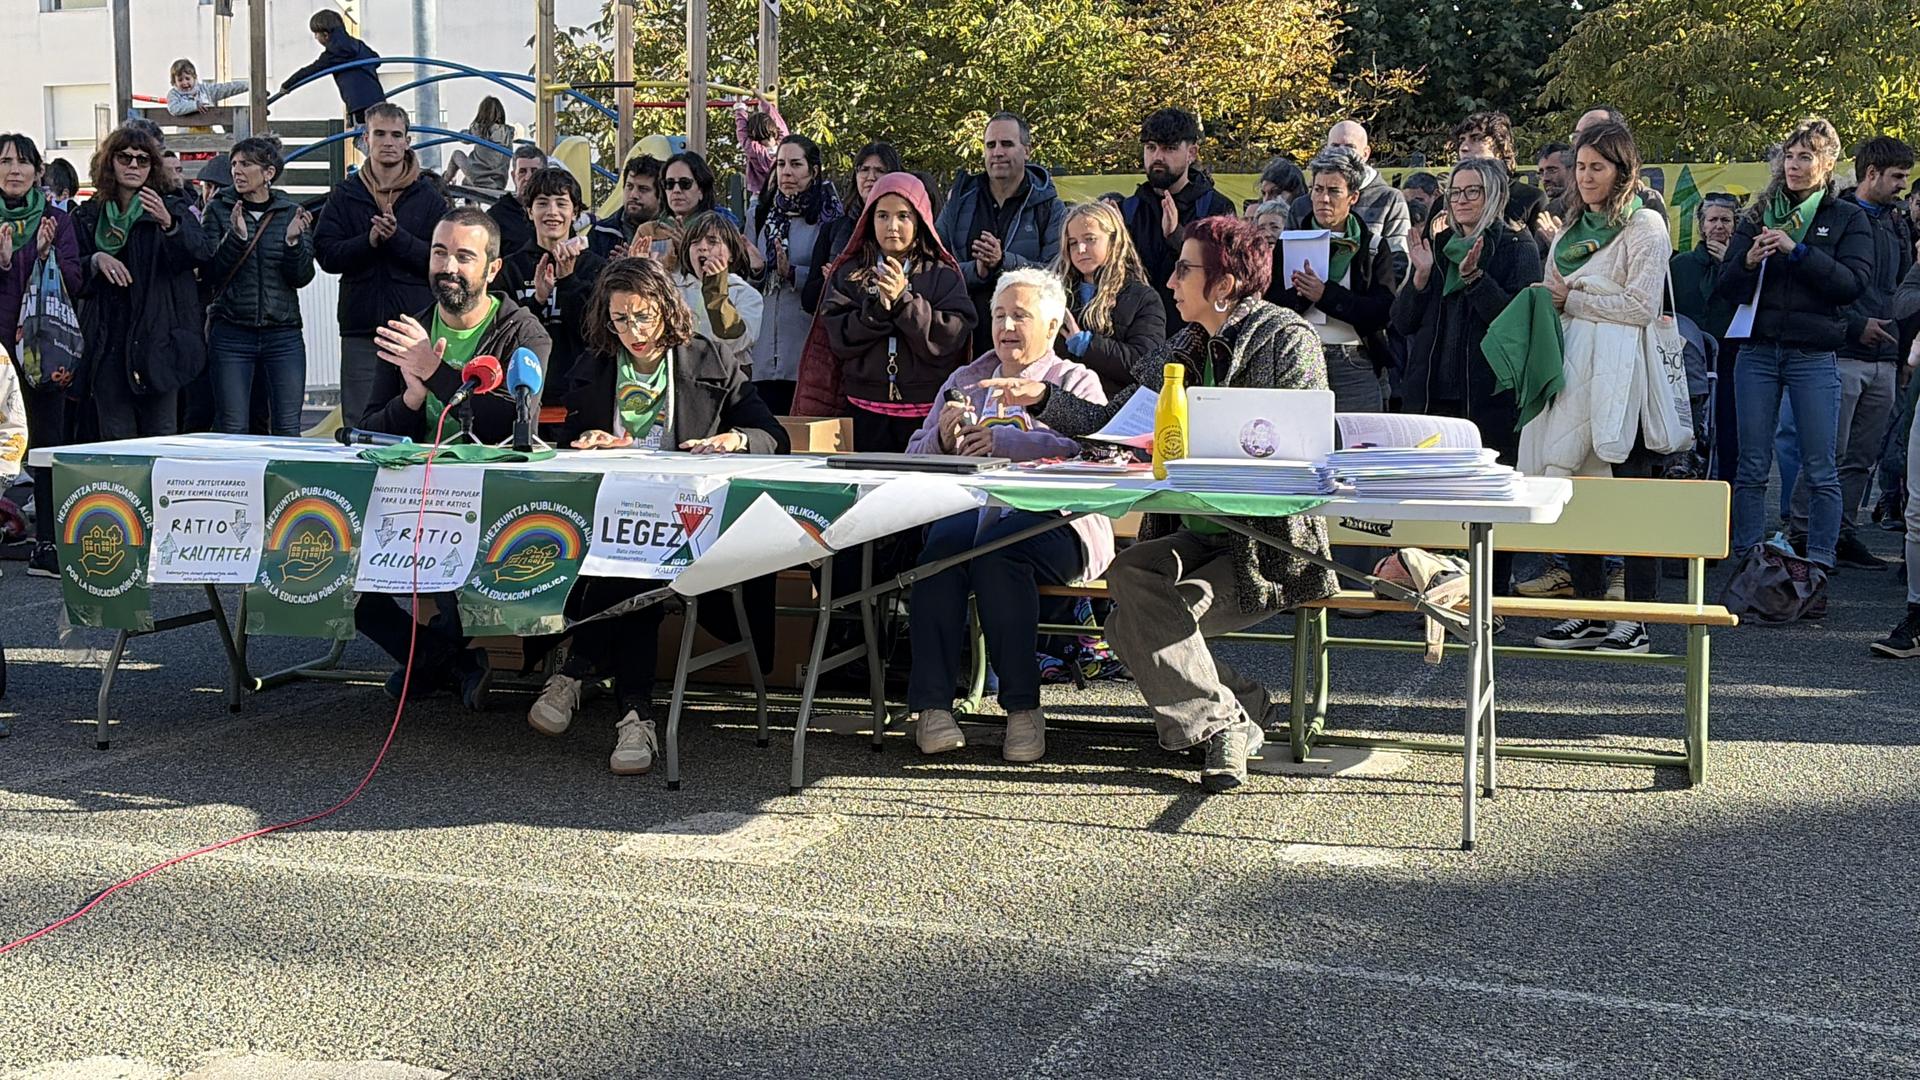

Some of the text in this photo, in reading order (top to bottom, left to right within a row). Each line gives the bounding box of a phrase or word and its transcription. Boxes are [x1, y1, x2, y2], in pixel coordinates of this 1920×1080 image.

[57, 481, 154, 529] HEZKUNTZA PUBLIKOAREN ALDE
[265, 486, 362, 534] HEZKUNTZA PUBLIKOAREN ALDE
[408, 498, 434, 506] BAJDA
[679, 505, 707, 515] JAITSI
[171, 518, 228, 534] RATIO
[482, 504, 530, 544] HEZKUNTZA
[530, 500, 588, 529] PUBLIKOAREN
[601, 516, 685, 548] LEGEZ
[398, 528, 462, 545] RATIO
[178, 545, 252, 562] KALITATEA
[369, 552, 436, 570] CALIDAD
[65, 564, 79, 583] POR
[79, 579, 88, 591] LA
[259, 570, 272, 589] POR
[269, 586, 279, 597] LA
[279, 591, 319, 604] EDUCACIÓN
[319, 573, 349, 600] PÚBLICA
[478, 585, 489, 596] LA
[488, 589, 531, 601] EDUCACIÓN
[531, 575, 568, 596] PÚBLICA
